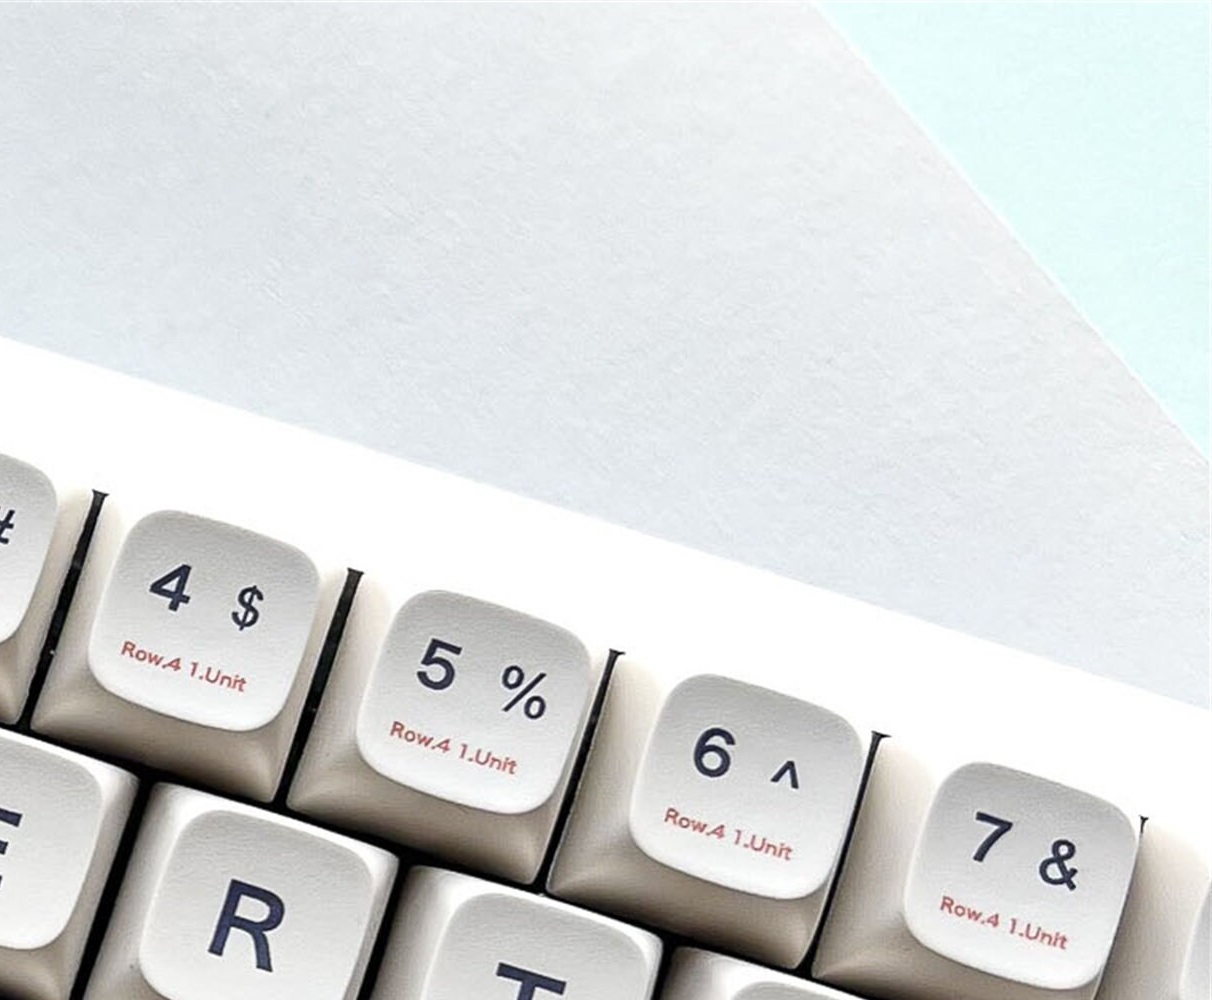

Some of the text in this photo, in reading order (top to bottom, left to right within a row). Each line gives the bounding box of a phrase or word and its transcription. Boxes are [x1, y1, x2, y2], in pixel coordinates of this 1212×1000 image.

[150, 565, 263, 630] 4 $
[121, 641, 246, 692] Row.4 1.Unit
[417, 639, 546, 719] 5 %
[391, 722, 517, 773] Row.4 1.Unit
[694, 728, 735, 777] 6
[665, 809, 792, 861] Row.4 1.Unit
[974, 812, 1077, 890] 7 &
[209, 879, 284, 972] R
[939, 896, 1068, 950] Row.4 1.Unit
